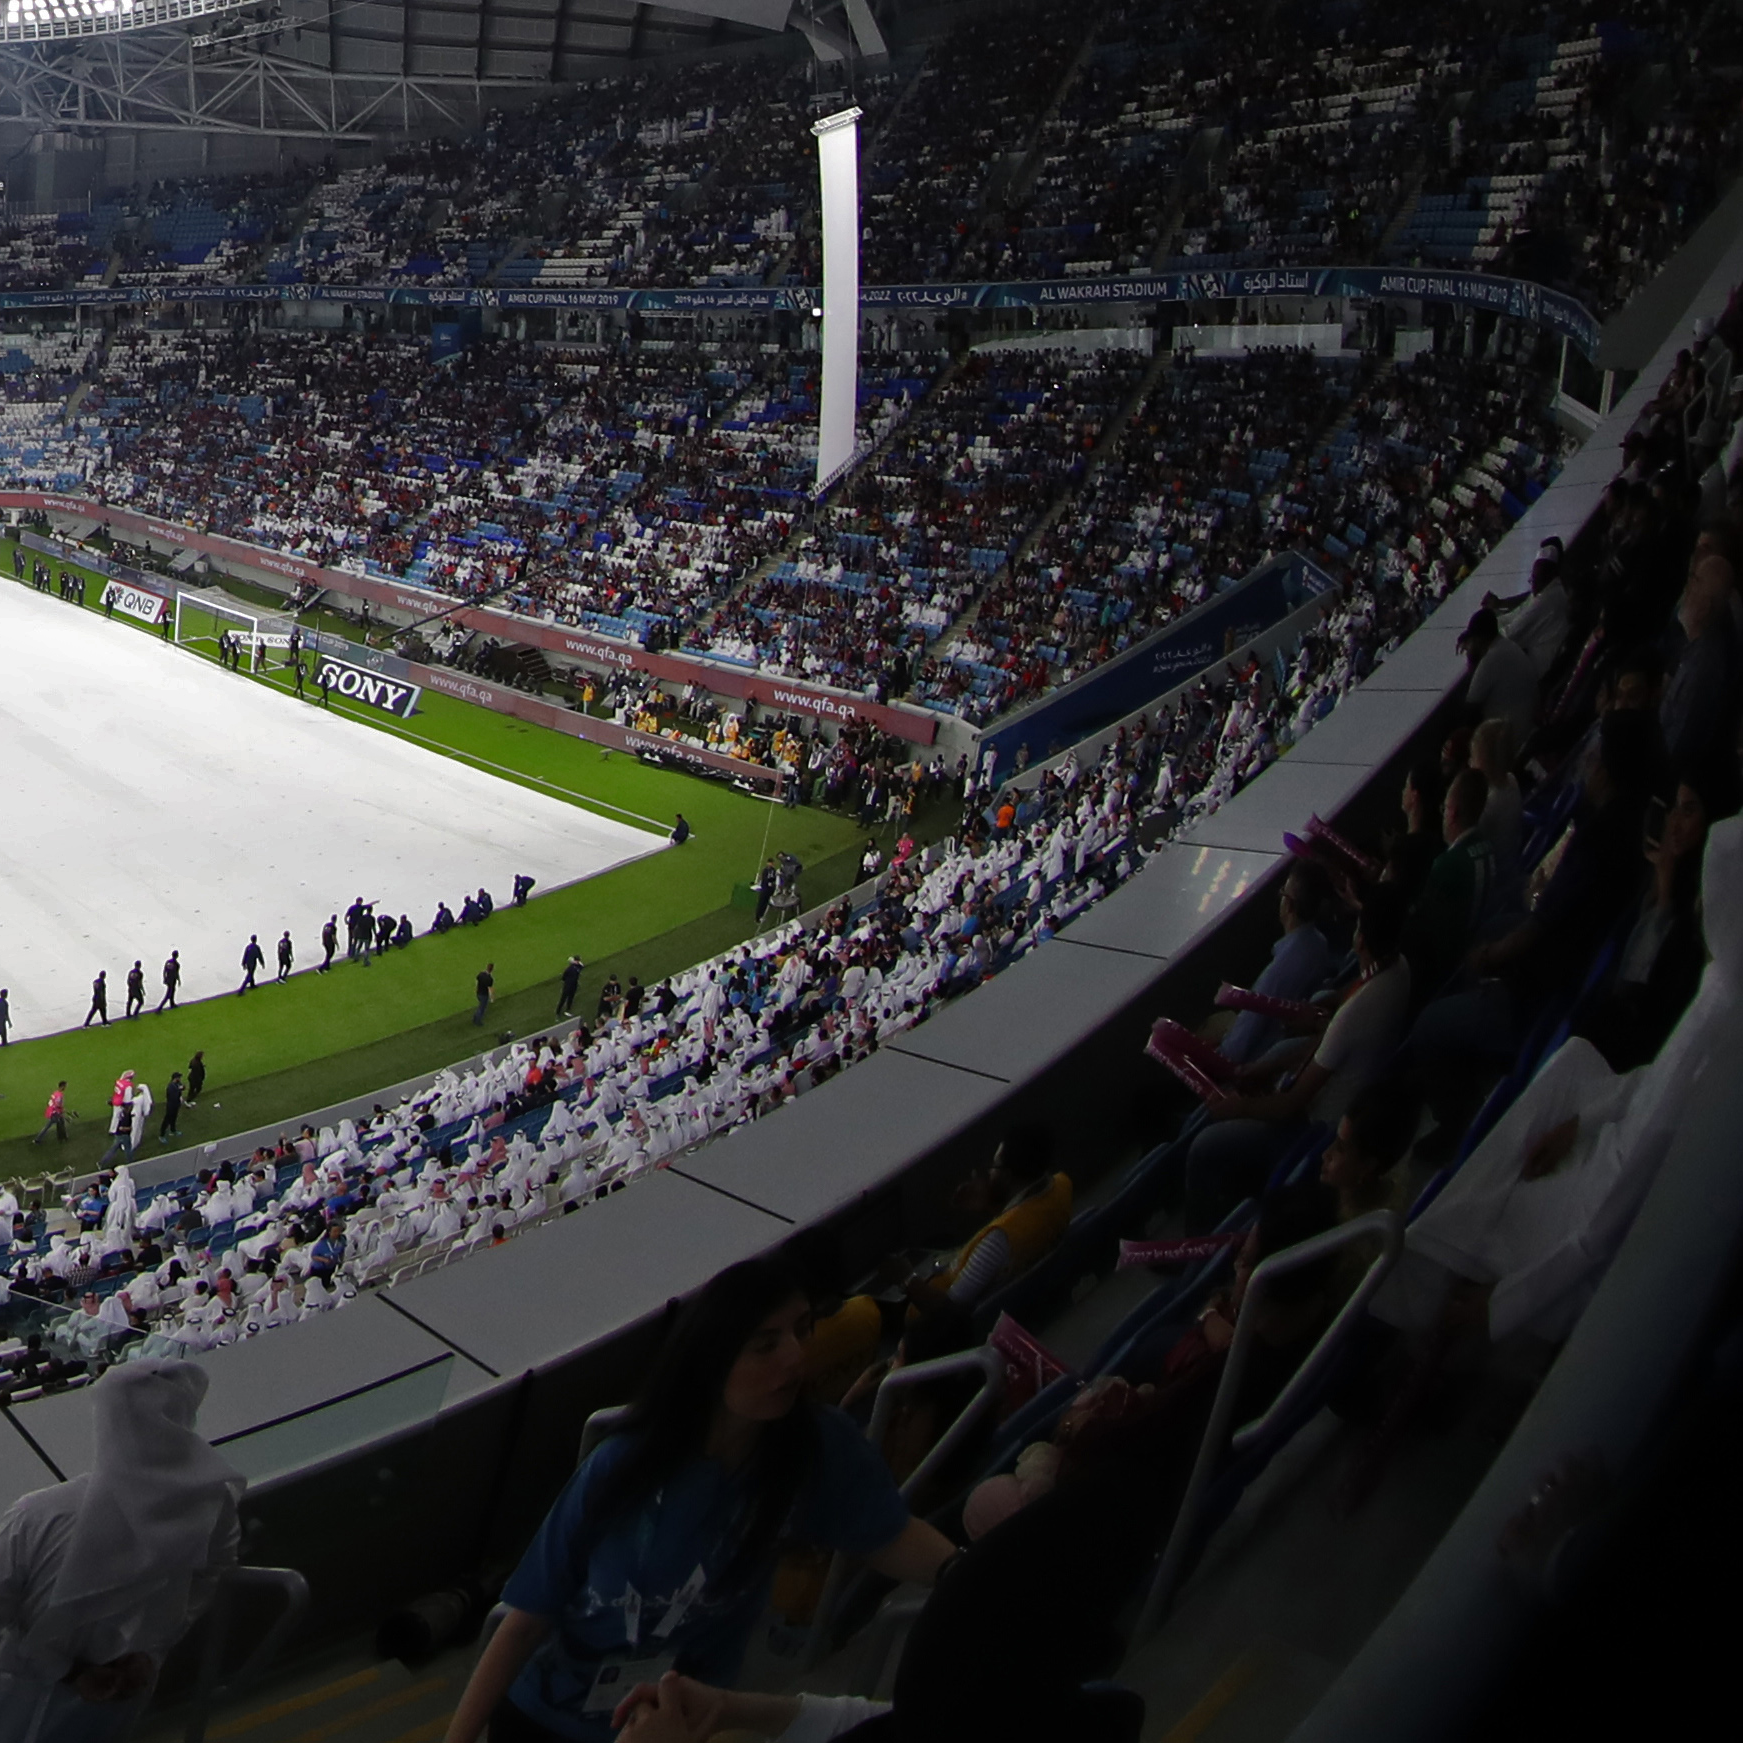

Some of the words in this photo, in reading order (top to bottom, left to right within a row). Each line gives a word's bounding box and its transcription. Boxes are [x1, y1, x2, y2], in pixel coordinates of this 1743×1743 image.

[321, 291, 330, 299] AL
[332, 291, 355, 300] WAKRAH
[357, 291, 385, 300] STADIUM
[507, 294, 528, 304] AMIR
[530, 294, 543, 305] CUP
[545, 294, 566, 305] FINAL
[568, 294, 578, 305] 16
[579, 294, 596, 305] MAY
[597, 294, 619, 305] 2019
[674, 295, 692, 304] 2019
[1040, 287, 1056, 299] AL
[1058, 285, 1111, 298] WAKRAH
[1114, 283, 1167, 296] STADIUM
[1380, 277, 1405, 291] AMIR
[1406, 278, 1423, 292] CUP
[1425, 280, 1454, 295] FINAL
[1458, 283, 1469, 296] 16
[1471, 284, 1487, 298] MAY
[1488, 287, 1508, 301] 2019
[148, 524, 186, 542] www.qfa.qa
[259, 556, 306, 578] www.qfa.qa
[122, 593, 155, 617] QNB
[565, 638, 633, 665] www.qfa.qa
[318, 663, 407, 712] SONY
[429, 674, 493, 703] www.qfa.qa
[774, 688, 856, 719] www.qfa.qa
